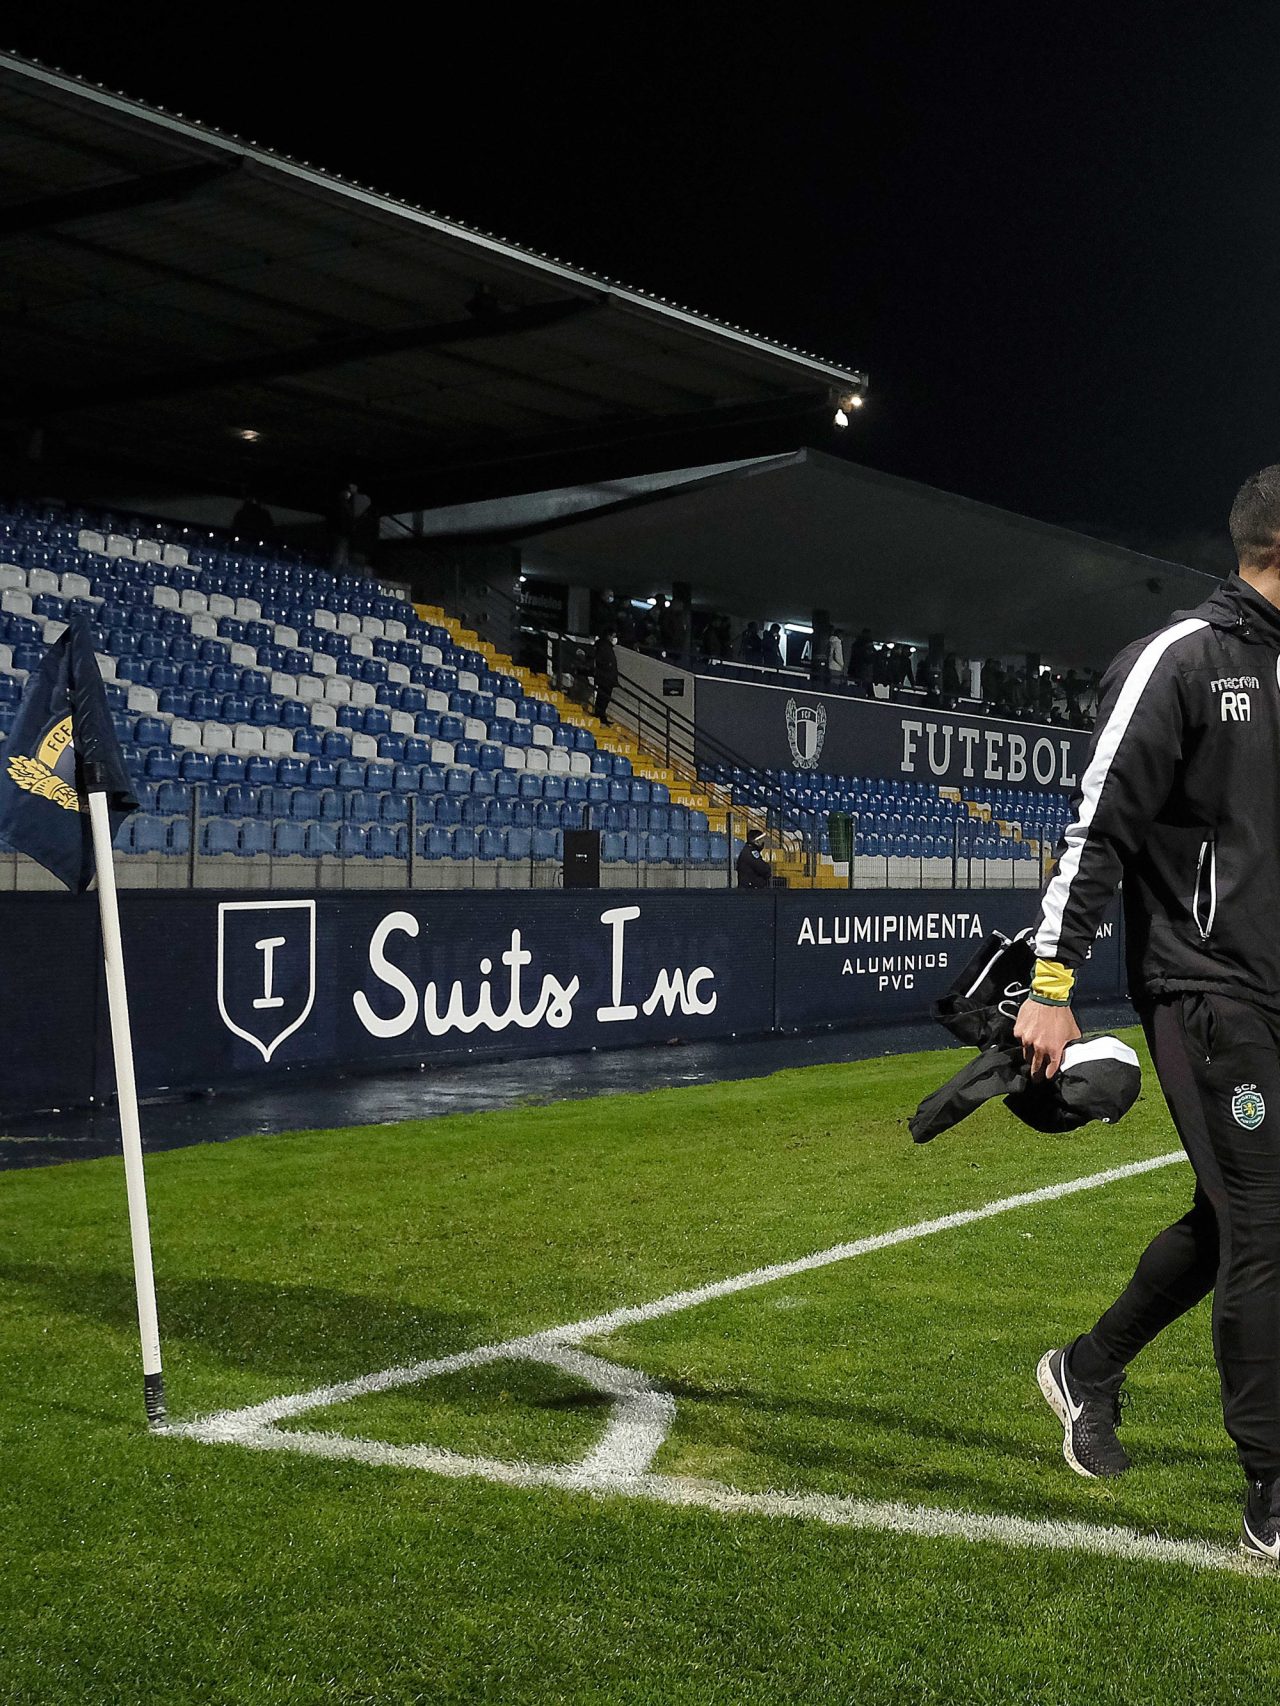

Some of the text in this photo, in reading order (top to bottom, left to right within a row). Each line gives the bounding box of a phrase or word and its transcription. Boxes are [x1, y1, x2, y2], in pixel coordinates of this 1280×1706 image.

[1210, 676, 1260, 693] macron
[1221, 691, 1251, 721] RA
[47, 724, 72, 752] FCF
[603, 743, 623, 754] FILA
[901, 719, 1077, 787] FUTEBOL
[640, 769, 667, 780] FILA D
[677, 796, 703, 807] FILA C
[797, 913, 984, 946] ALUMIPIMENTA
[352, 905, 717, 1038] Suits Inc
[842, 952, 949, 975] ALUMINIOS
[879, 973, 914, 992] PVC
[1234, 1083, 1257, 1094] SCP
